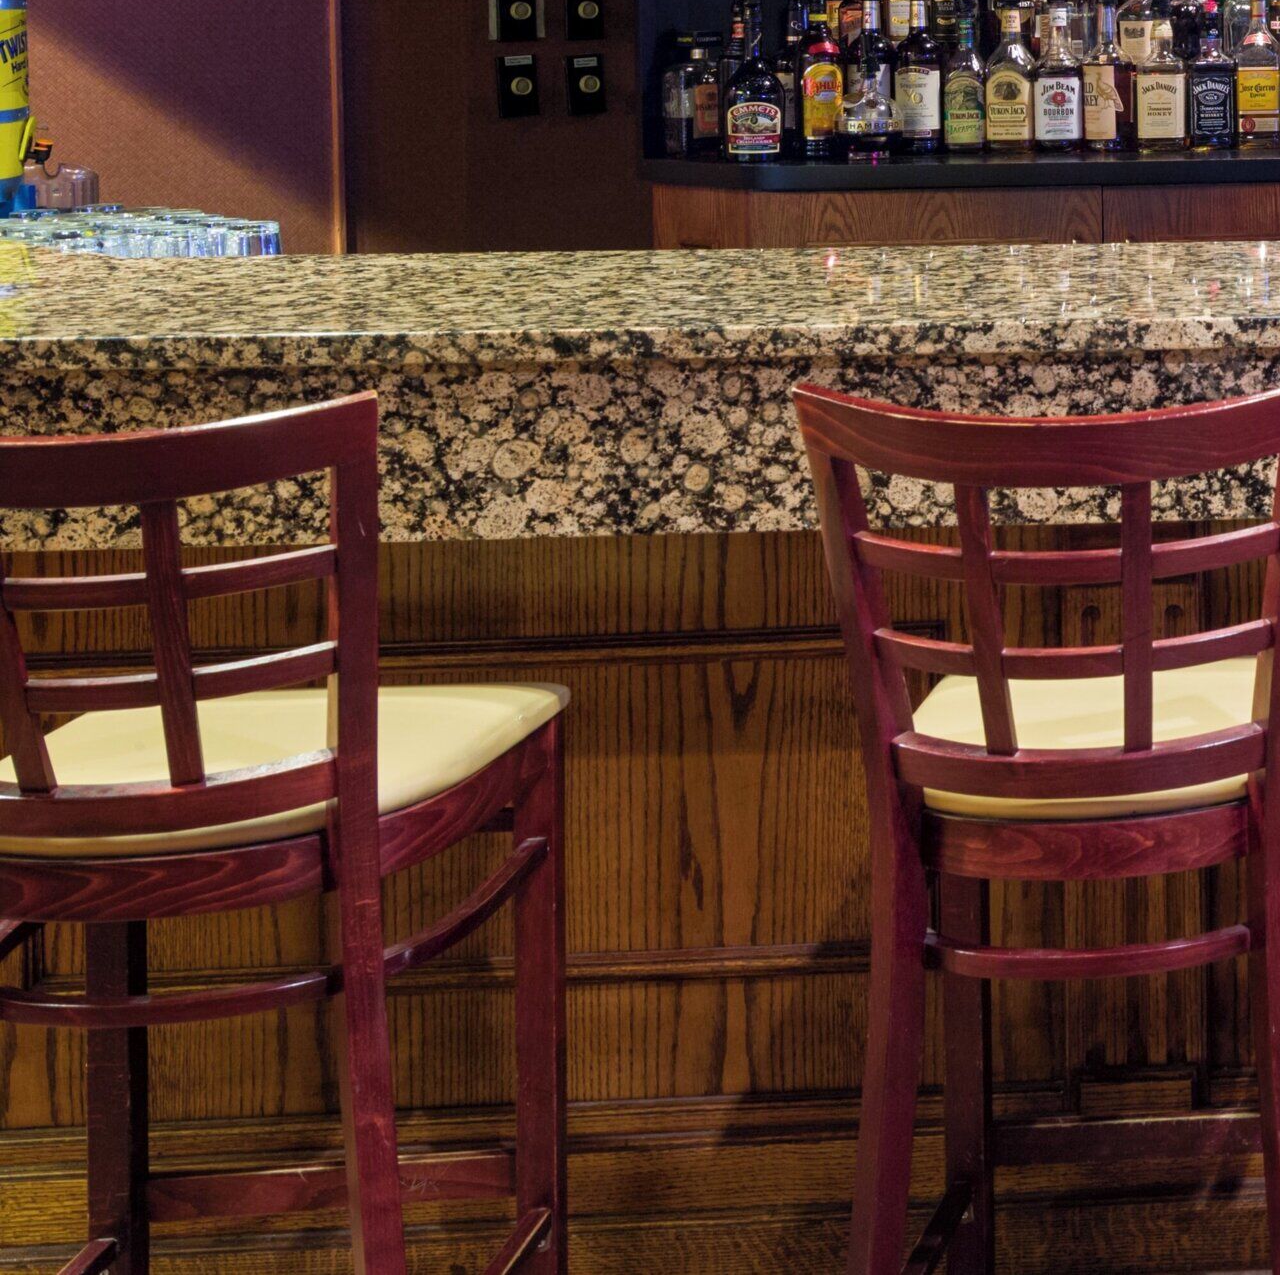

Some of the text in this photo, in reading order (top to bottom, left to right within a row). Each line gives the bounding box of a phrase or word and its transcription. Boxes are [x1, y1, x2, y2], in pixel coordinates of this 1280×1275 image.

[1041, 81, 1076, 96] JIM BEAM
[1141, 81, 1178, 95] JACK DANIEL'S
[1192, 80, 1231, 95] JACK DANIEL'S
[1254, 83, 1276, 93] Cuervo
[732, 104, 777, 117] EMMETS
[990, 105, 1025, 116] YUKON JACK
[1043, 107, 1074, 117] BOURBON
[846, 120, 899, 131] HAMBORD
